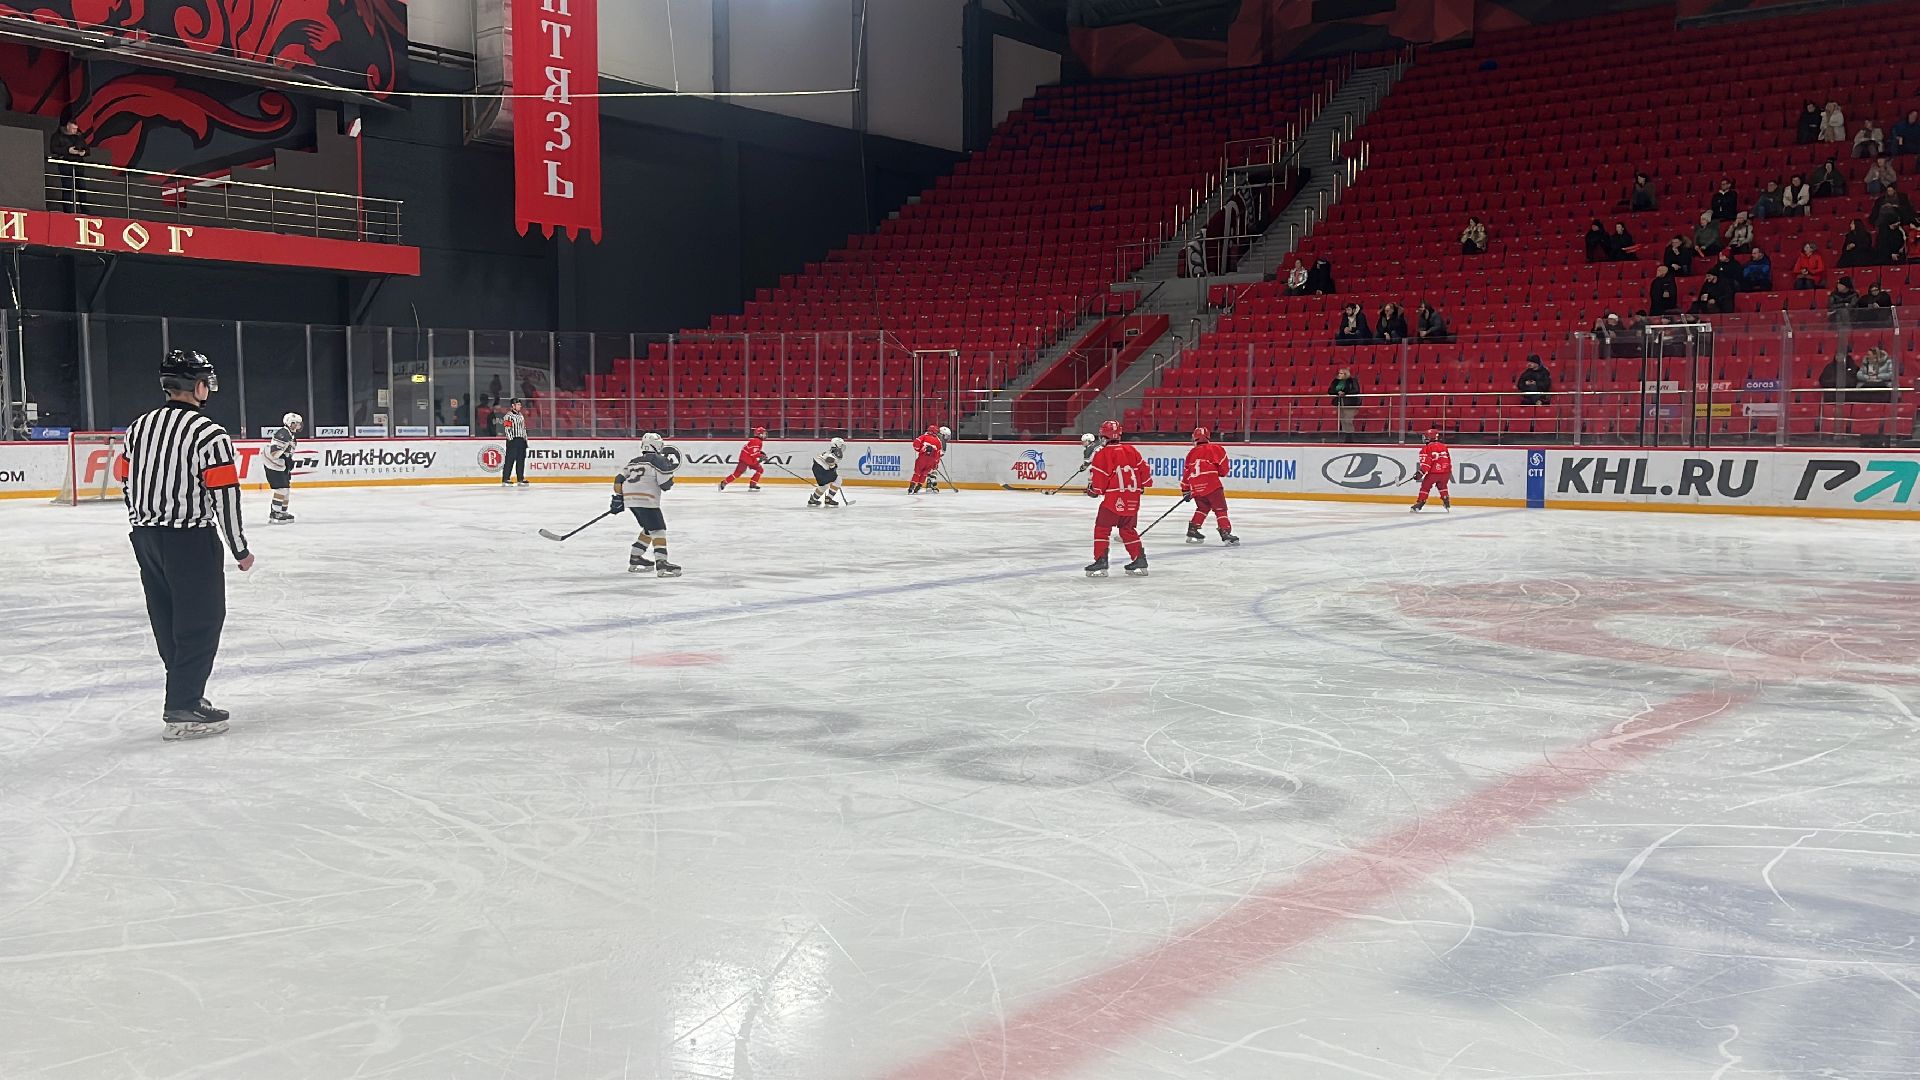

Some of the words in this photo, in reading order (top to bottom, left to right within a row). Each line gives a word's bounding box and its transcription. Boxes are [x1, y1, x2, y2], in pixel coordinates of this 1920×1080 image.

[75, 217, 193, 253] БОГ
[324, 448, 437, 468] MarkHockey
[528, 449, 562, 459] ЛЕТЫ
[566, 447, 615, 459] ОНЛАЙН
[685, 454, 792, 464] VALAI
[872, 455, 901, 465] ГАЗПРОМ
[364, 466, 416, 474] YOURSELF
[530, 462, 591, 470] HCVITYAZ.RU
[1011, 462, 1035, 470] АВТО
[1018, 471, 1047, 480] РАДИО
[1115, 465, 1138, 493] 13
[1557, 457, 1759, 498] KHL.RU
